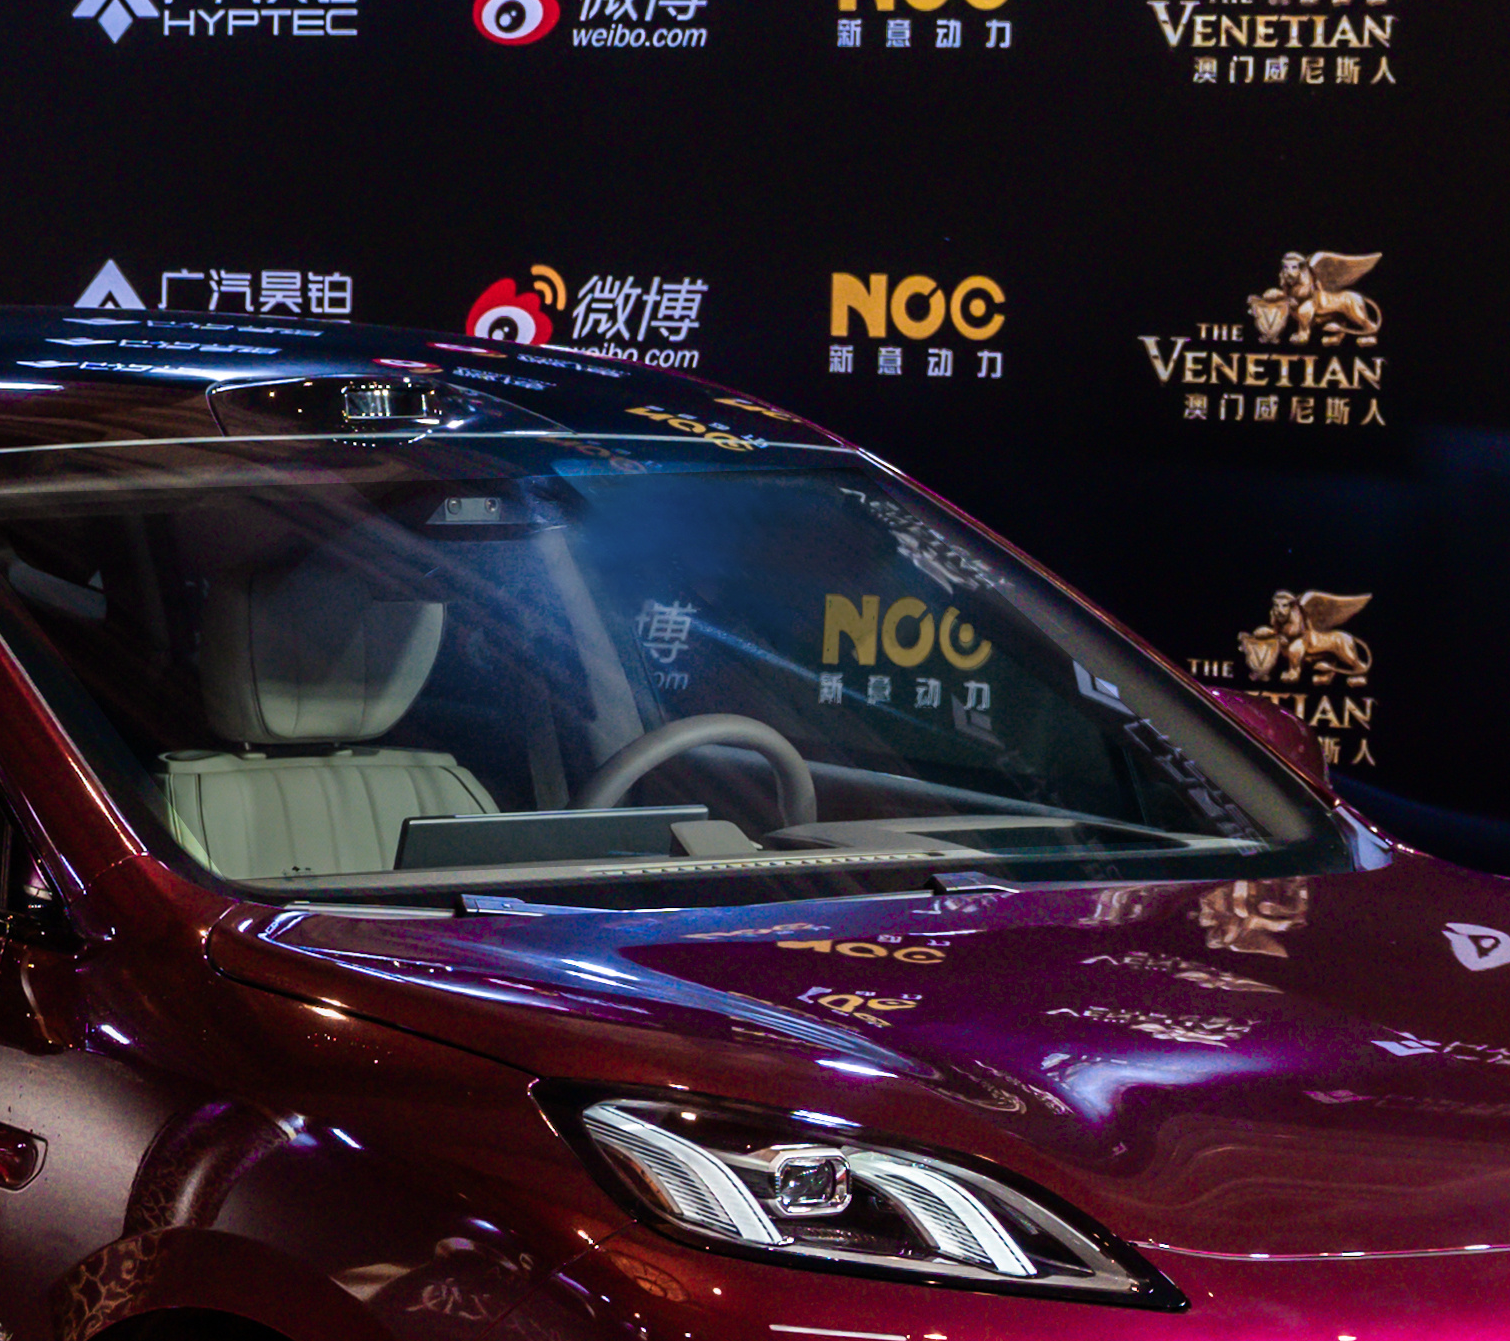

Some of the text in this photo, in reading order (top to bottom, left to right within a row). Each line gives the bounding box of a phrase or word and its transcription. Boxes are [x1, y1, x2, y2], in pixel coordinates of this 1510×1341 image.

[163, 8, 359, 36] HYPTEC
[572, 23, 708, 48] weibo.com
[1146, 0, 1395, 48] VENETIAN
[1192, 54, 1396, 85] 澳门威尼斯人
[156, 268, 353, 316] 广汽昊铂
[572, 274, 709, 342] 微博
[830, 272, 1006, 341] NOC
[1138, 335, 1384, 390] VENETIAN
[1183, 392, 1386, 426] 澳门威尼斯人
